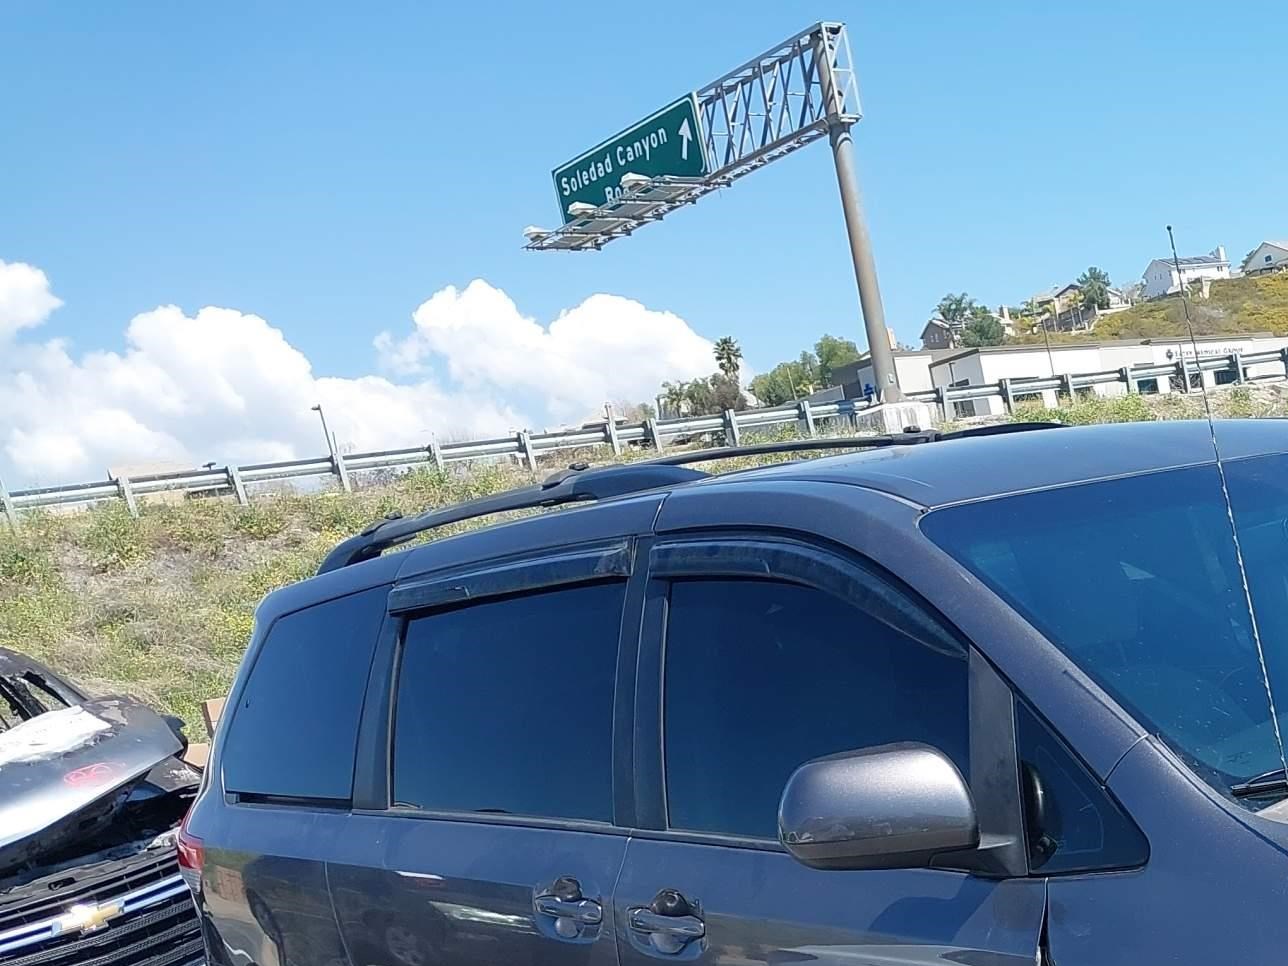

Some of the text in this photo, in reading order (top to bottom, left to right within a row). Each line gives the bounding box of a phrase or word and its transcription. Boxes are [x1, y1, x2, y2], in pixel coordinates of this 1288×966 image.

[561, 127, 668, 196] Soledad Canyon
[604, 186, 630, 203] Ro
